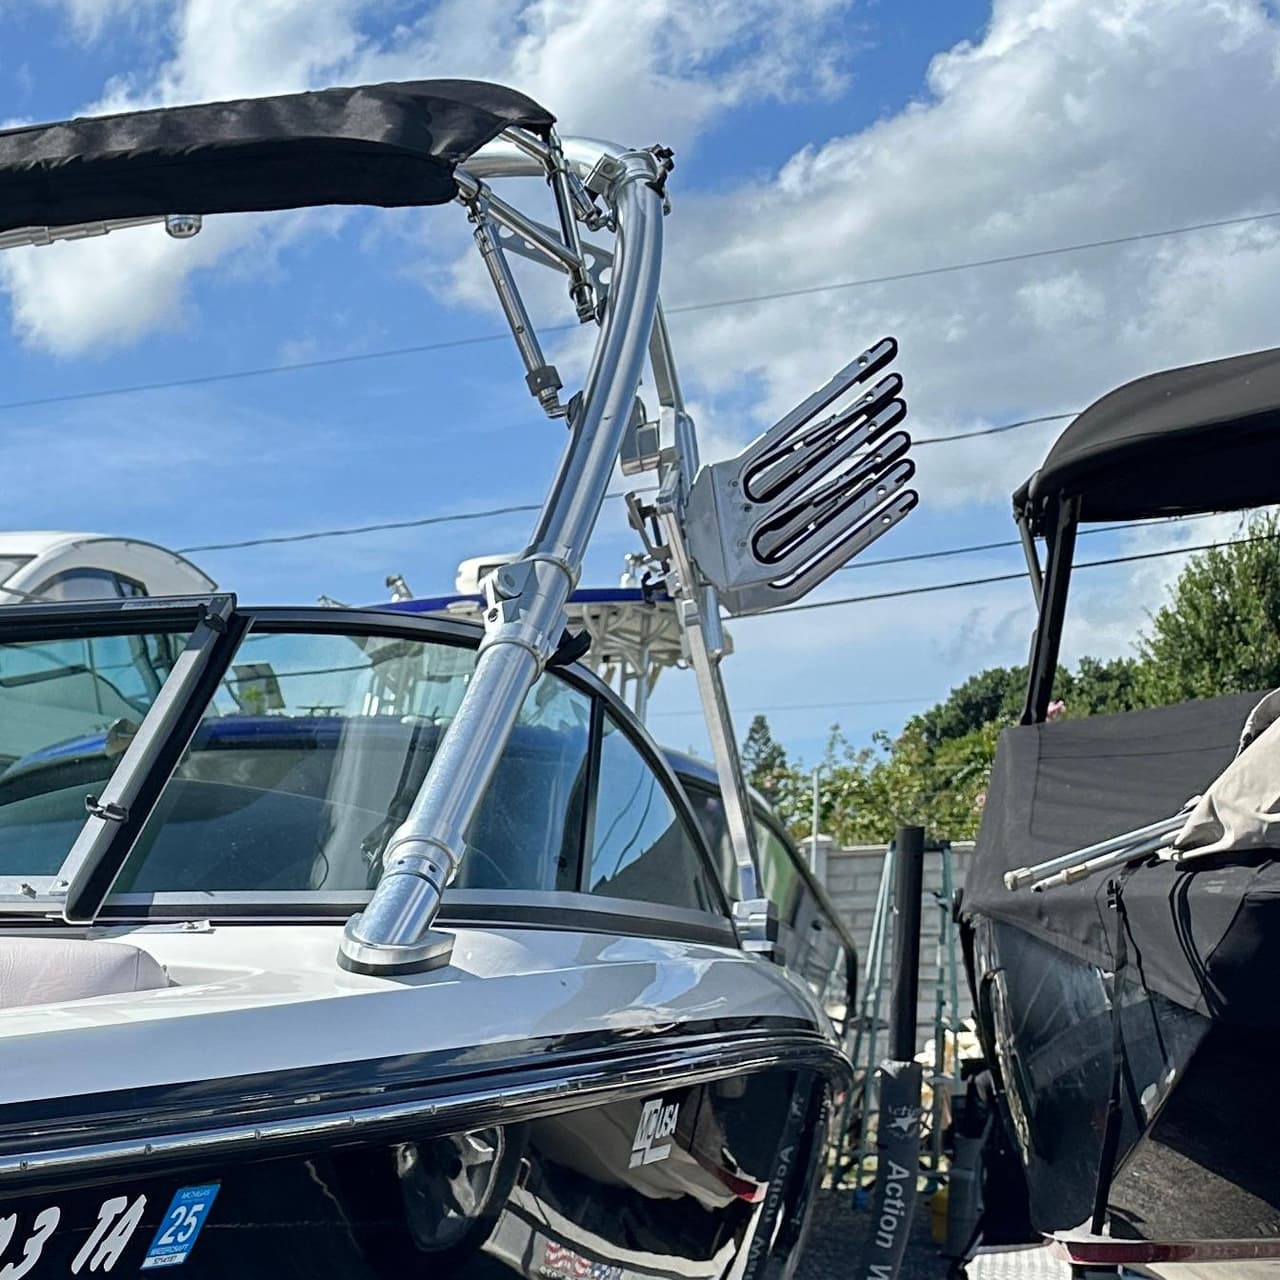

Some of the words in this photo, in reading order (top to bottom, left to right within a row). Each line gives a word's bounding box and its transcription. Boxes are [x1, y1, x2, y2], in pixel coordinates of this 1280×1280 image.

[71, 1194, 147, 1274] TA
[158, 1204, 205, 1245] 25
[876, 1160, 911, 1249] Action
